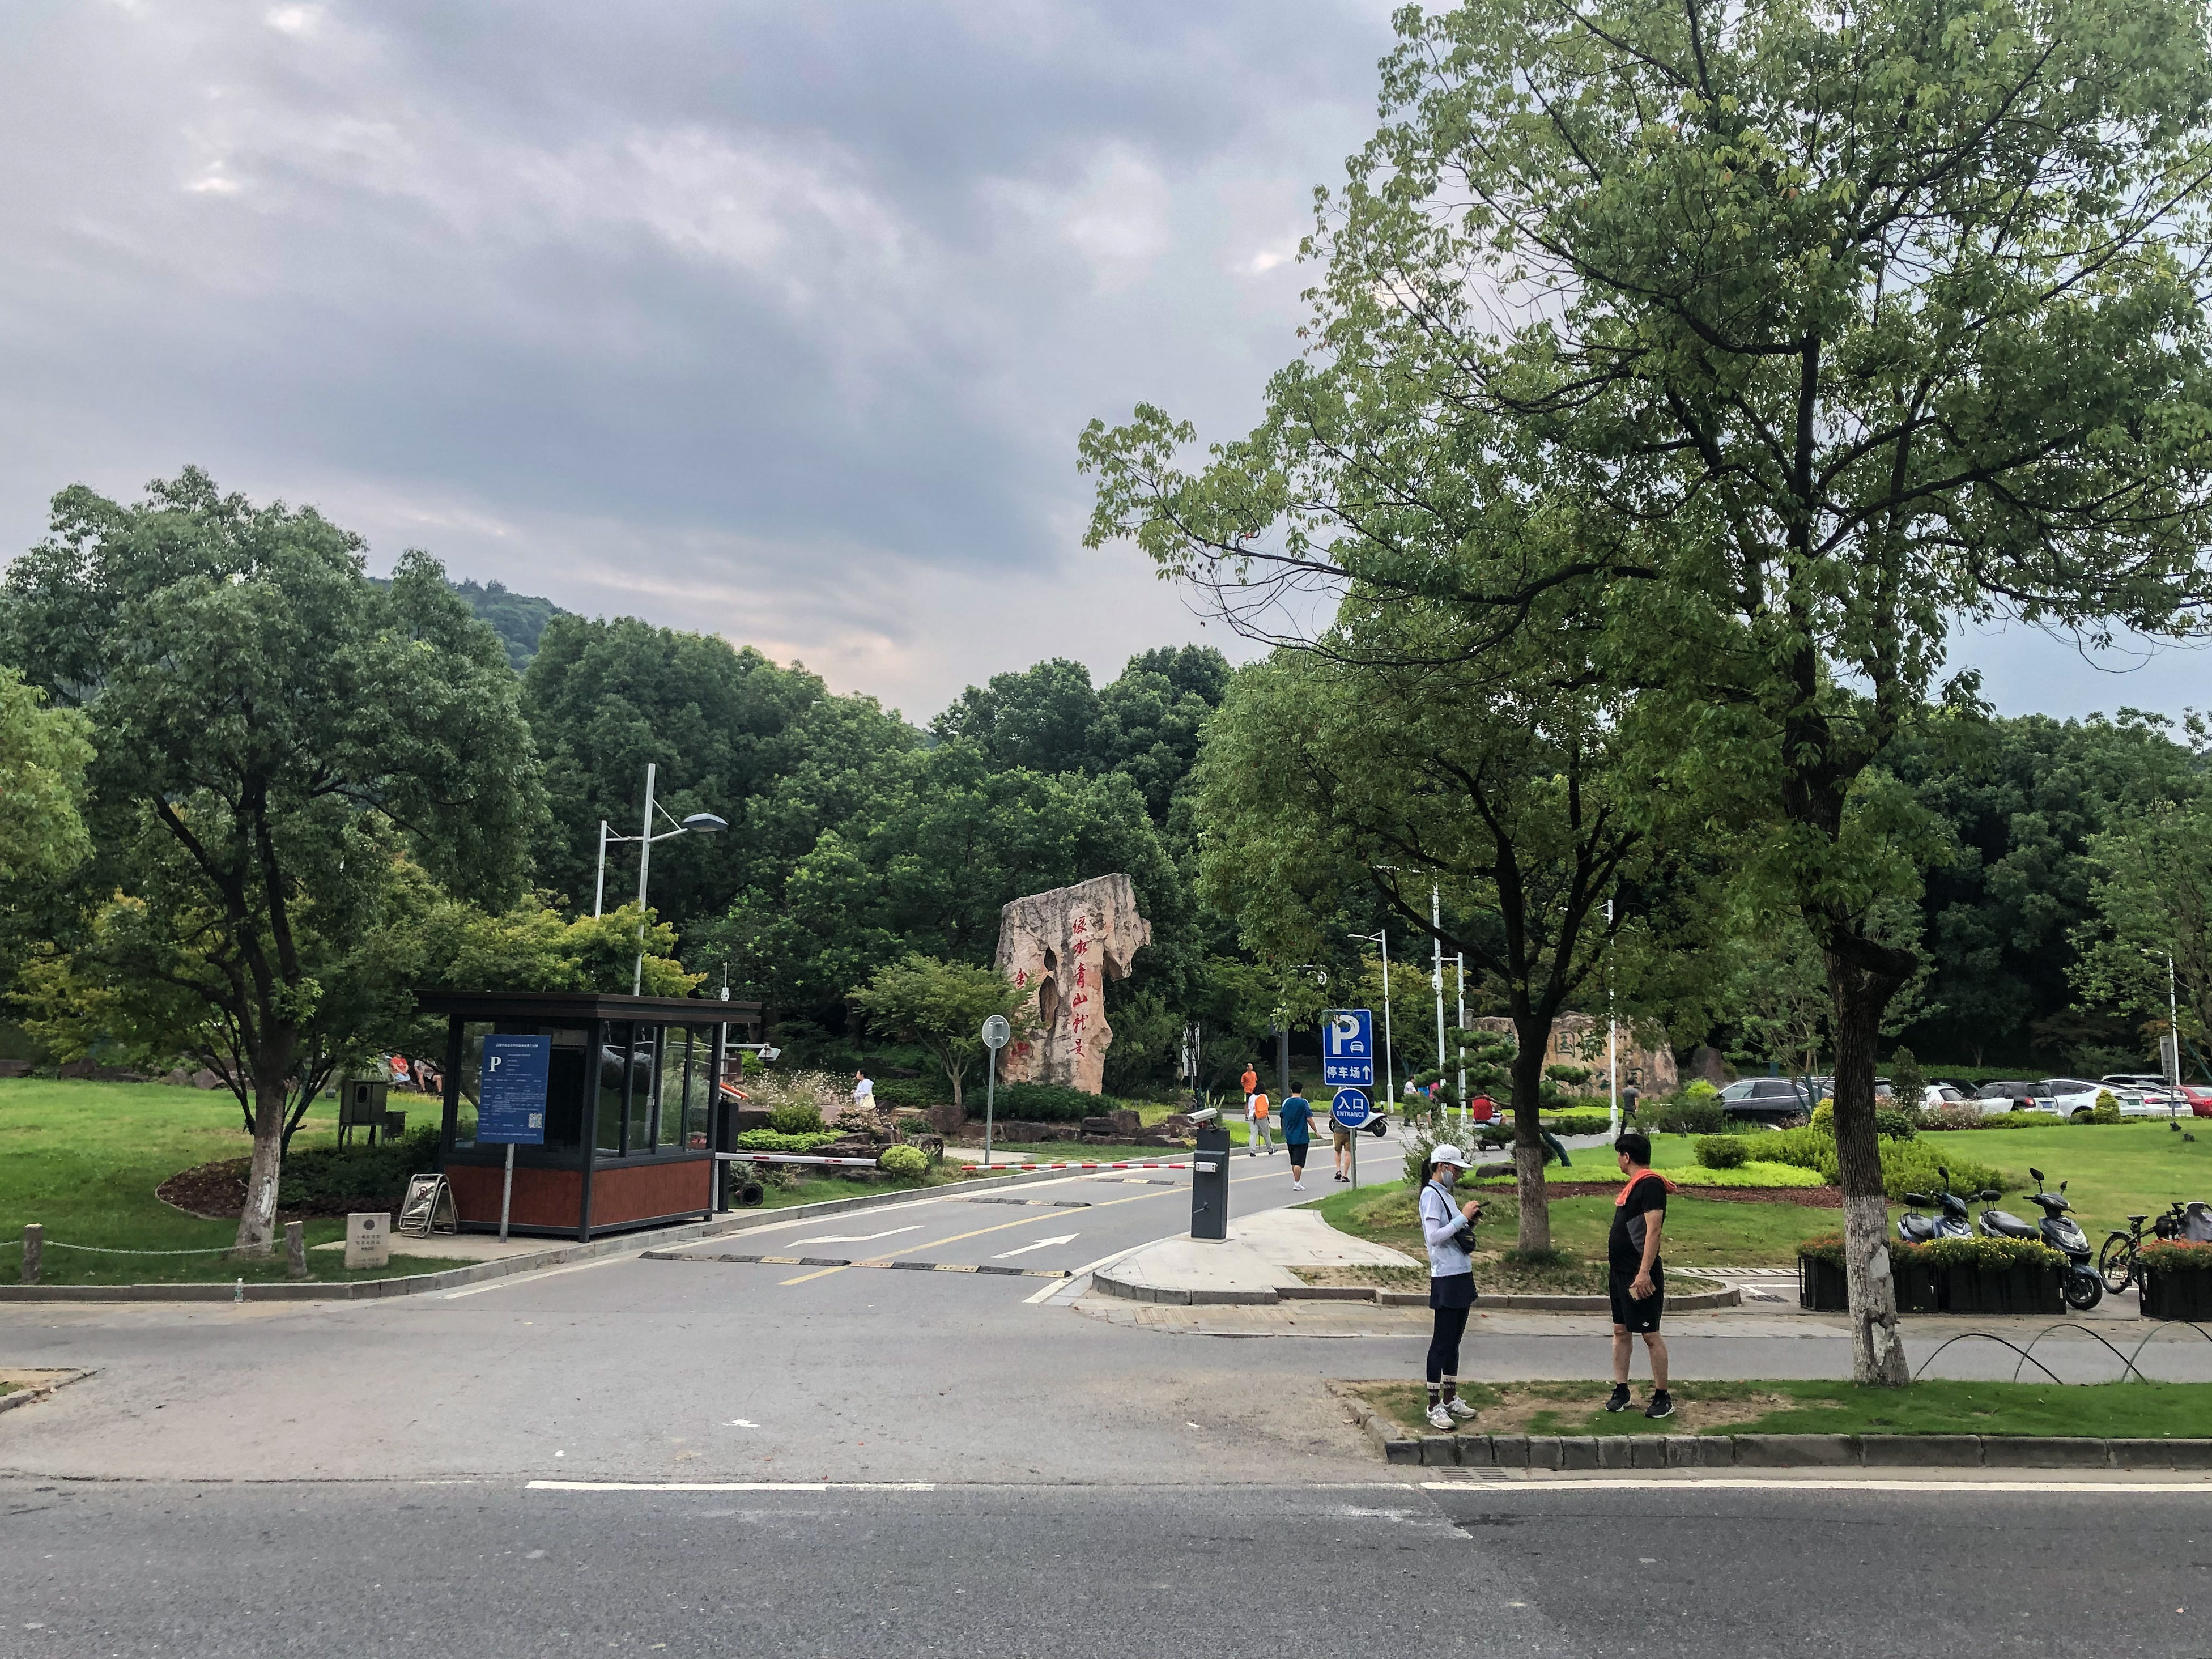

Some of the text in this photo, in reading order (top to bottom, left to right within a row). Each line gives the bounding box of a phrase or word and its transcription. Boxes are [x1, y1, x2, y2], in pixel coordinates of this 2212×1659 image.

[1332, 1015, 1360, 1054] P
[489, 1056, 501, 1072] P
[1326, 1065, 1360, 1079] 停车场
[1337, 1096, 1364, 1111] 入口
